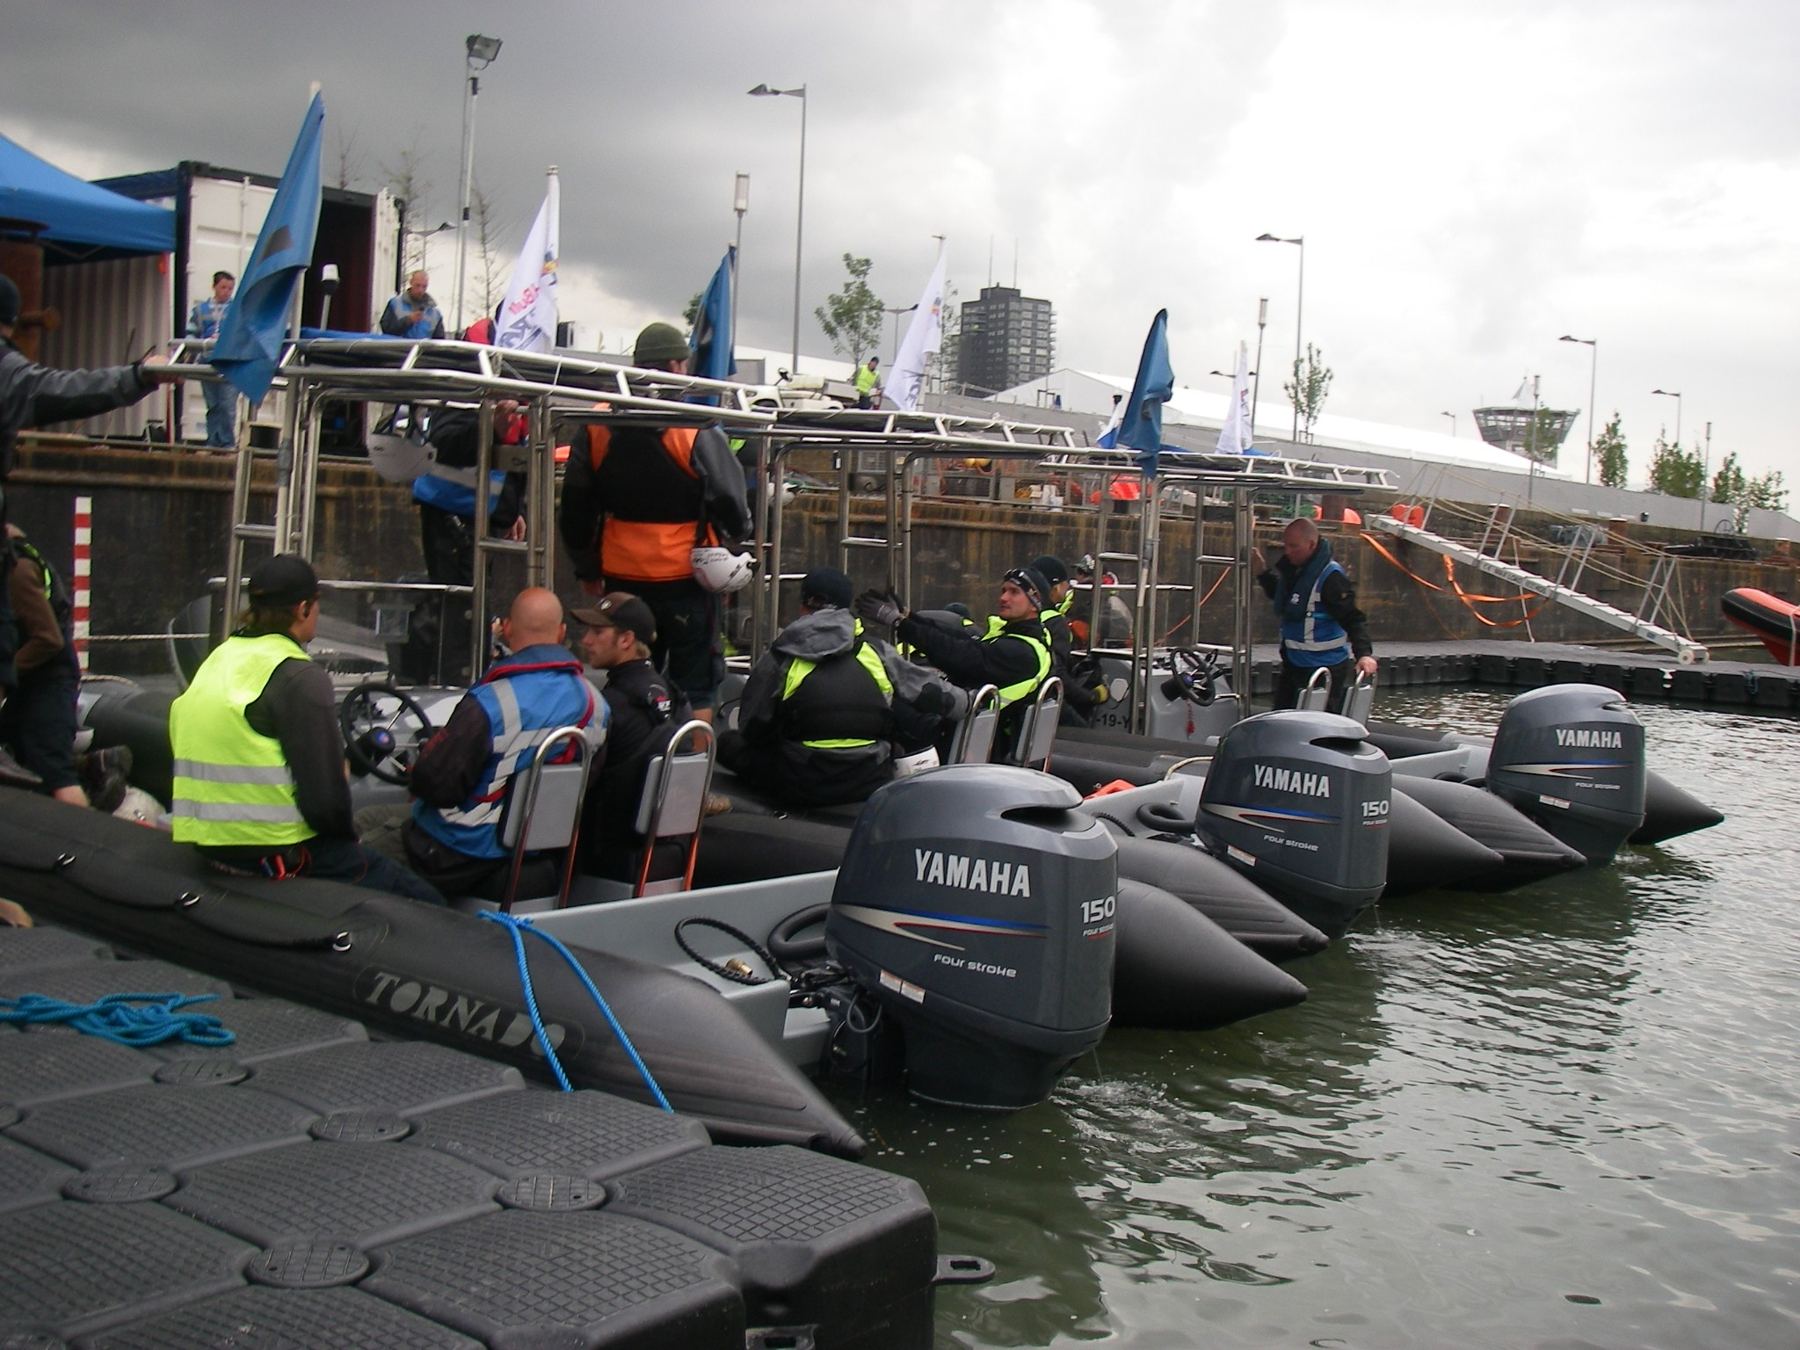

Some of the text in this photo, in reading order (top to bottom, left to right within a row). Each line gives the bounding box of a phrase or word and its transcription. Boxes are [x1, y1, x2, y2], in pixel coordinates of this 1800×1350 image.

[1556, 729, 1622, 749] YAMAHA
[1254, 764, 1330, 798] YAMAHA
[1361, 800, 1389, 817] 150
[915, 848, 1030, 898] YAMAHA
[1080, 896, 1115, 924] 150
[366, 971, 566, 1057] TORNADO
